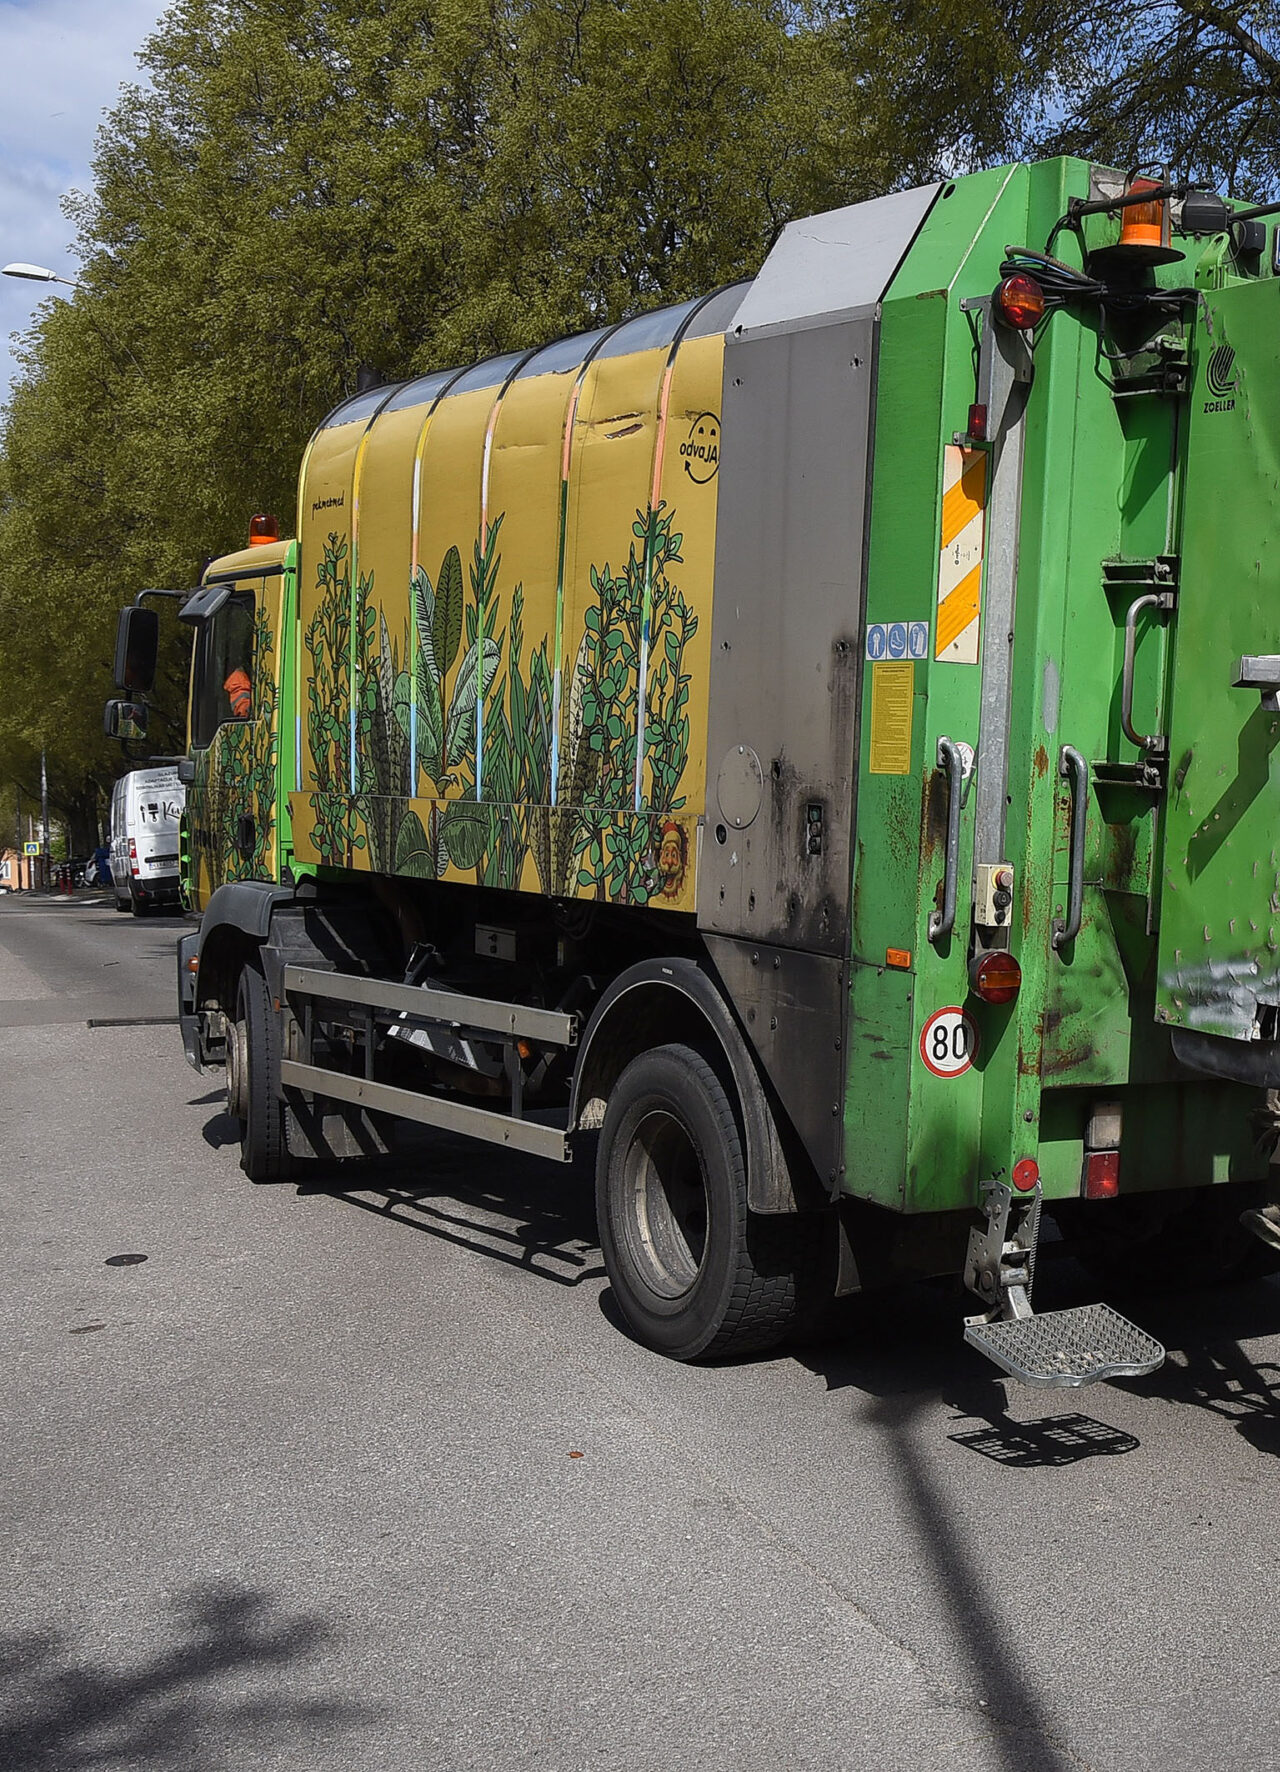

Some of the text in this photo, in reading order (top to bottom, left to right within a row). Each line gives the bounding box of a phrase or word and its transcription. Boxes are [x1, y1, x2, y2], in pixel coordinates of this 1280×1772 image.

[1203, 400, 1236, 414] ZOELLER
[679, 439, 718, 465] odvaJA
[932, 1023, 968, 1061] 80
